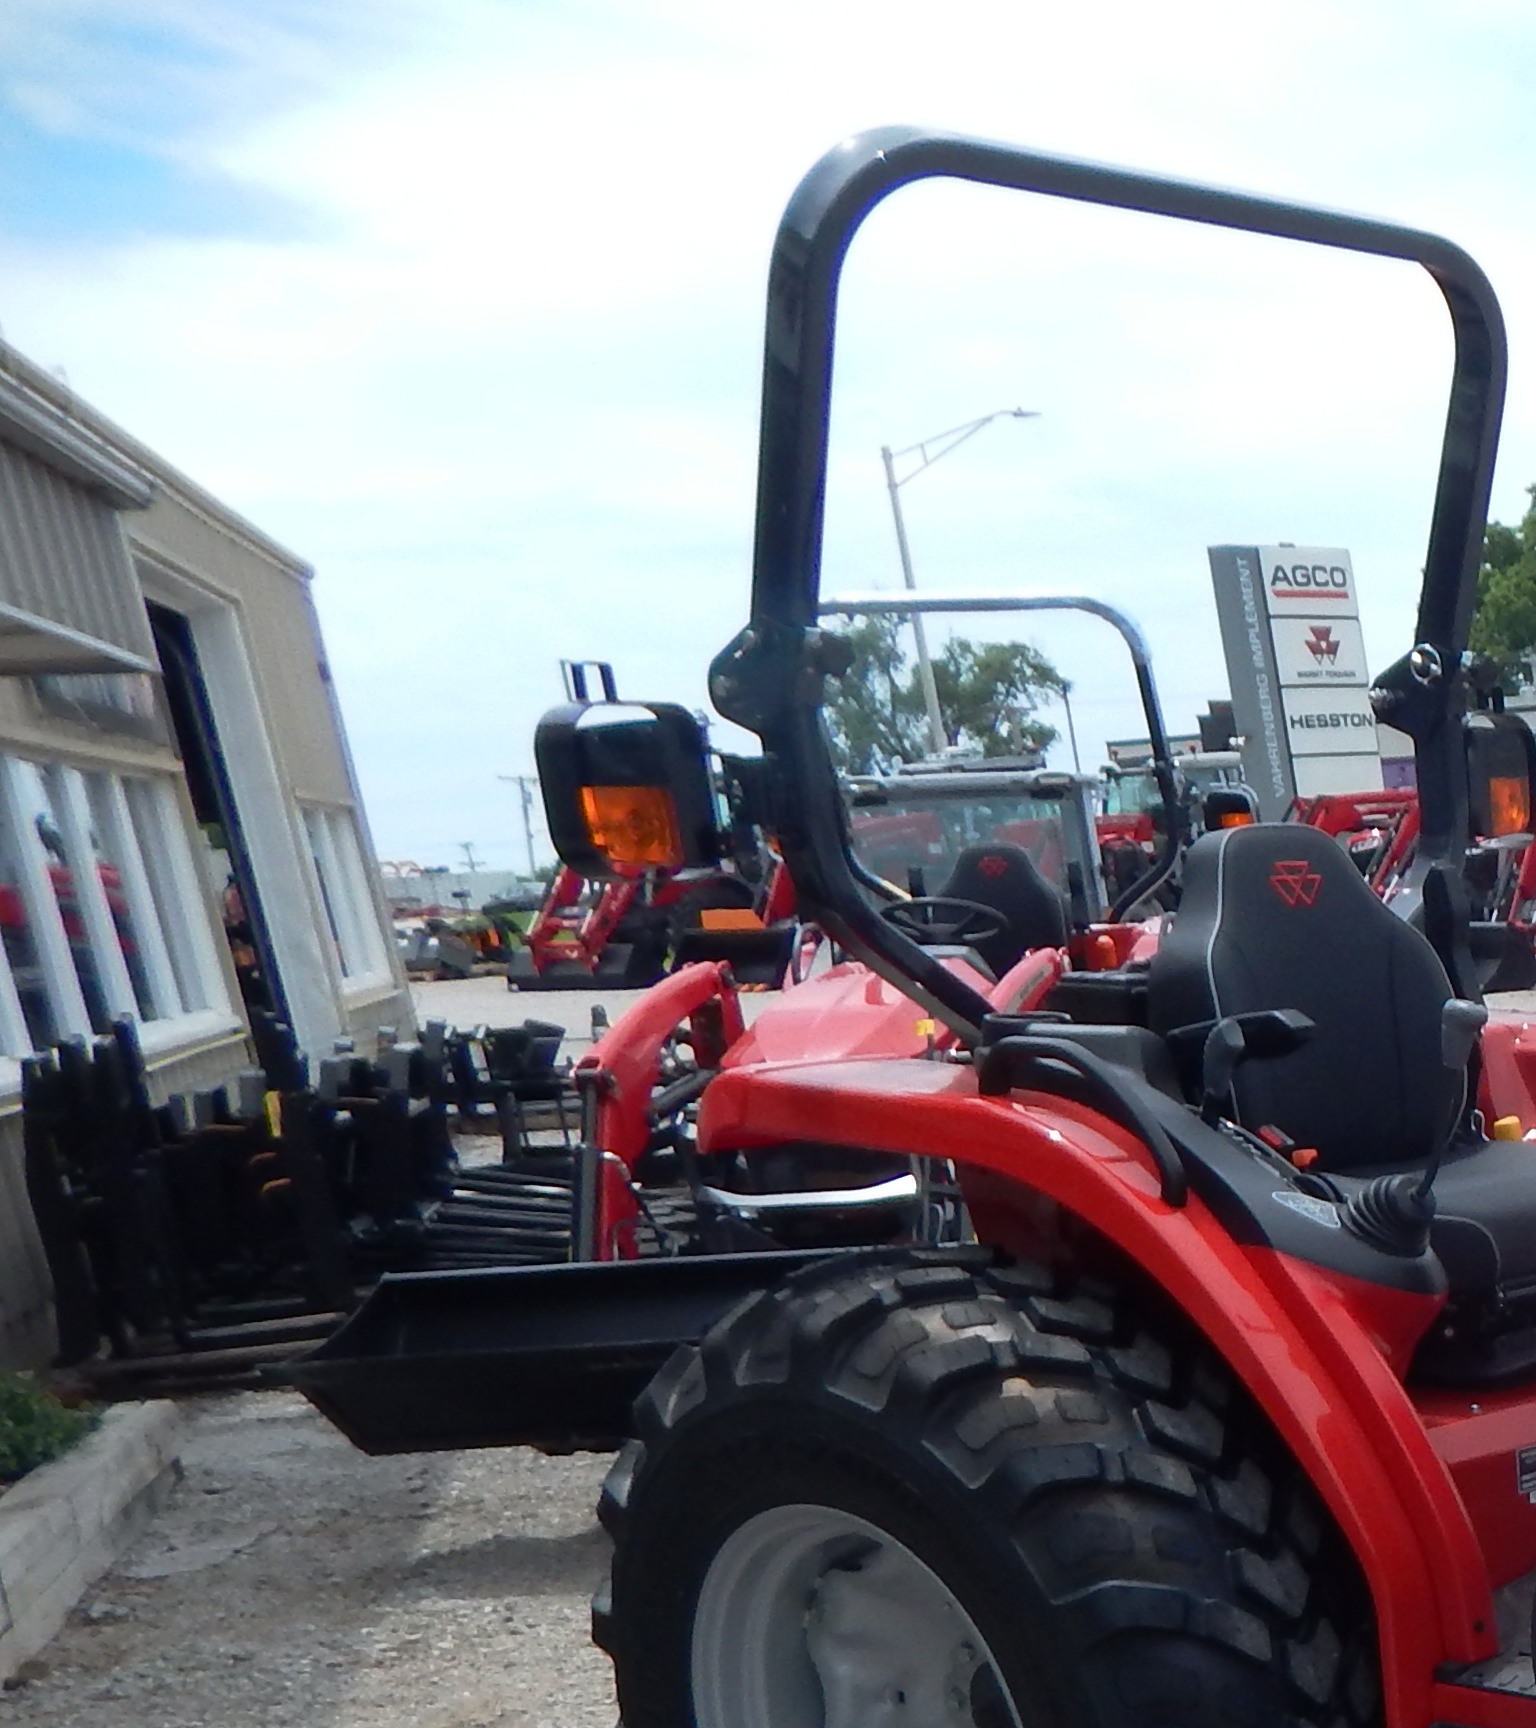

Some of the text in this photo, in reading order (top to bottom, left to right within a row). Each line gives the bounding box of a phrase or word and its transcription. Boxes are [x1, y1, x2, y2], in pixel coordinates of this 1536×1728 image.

[1271, 565, 1347, 588] AGCO
[1237, 557, 1265, 669] IMPLEMENT
[1290, 713, 1373, 730] HESSTON
